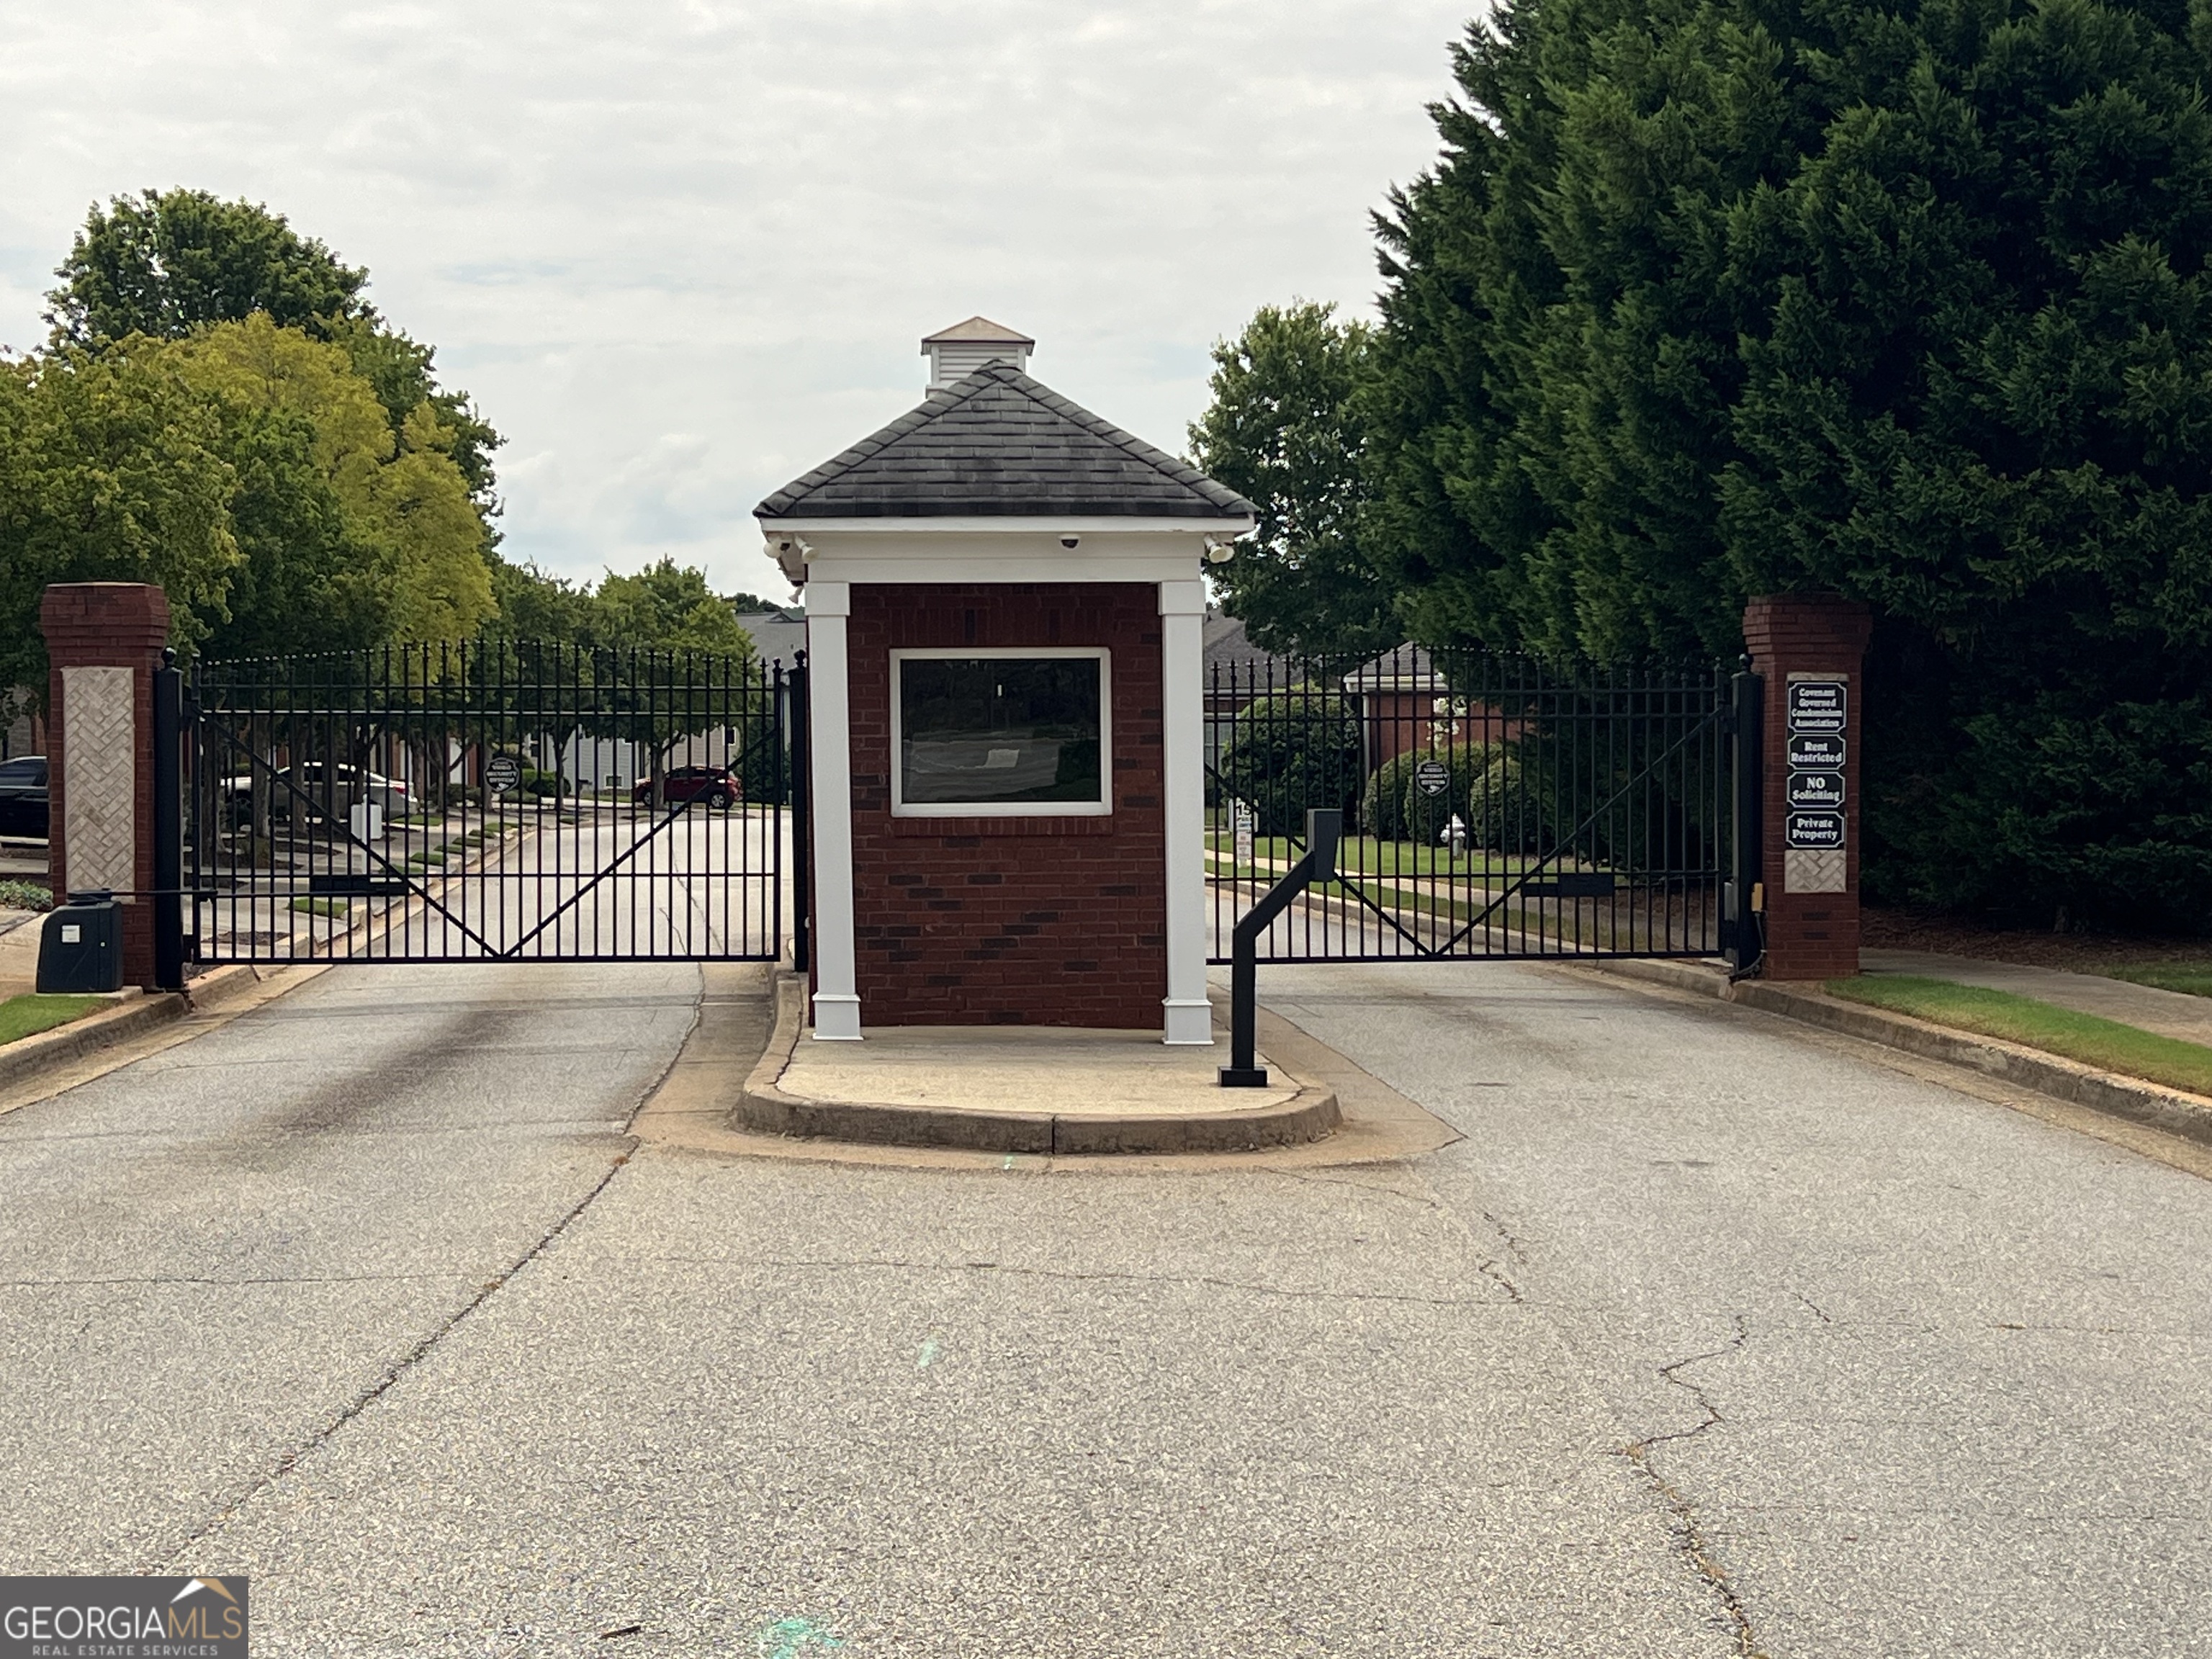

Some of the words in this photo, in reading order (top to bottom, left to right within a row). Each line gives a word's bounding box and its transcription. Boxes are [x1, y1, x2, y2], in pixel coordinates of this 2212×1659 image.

[1799, 688, 1836, 697] Covenant
[1798, 698, 1836, 707] Governed
[1804, 742, 1828, 752] Rent
[1791, 752, 1843, 763] Restricted
[1806, 778, 1825, 788] NO
[1792, 790, 1840, 801] Soliciting
[1797, 818, 1833, 828] Private
[1791, 829, 1838, 840] Property
